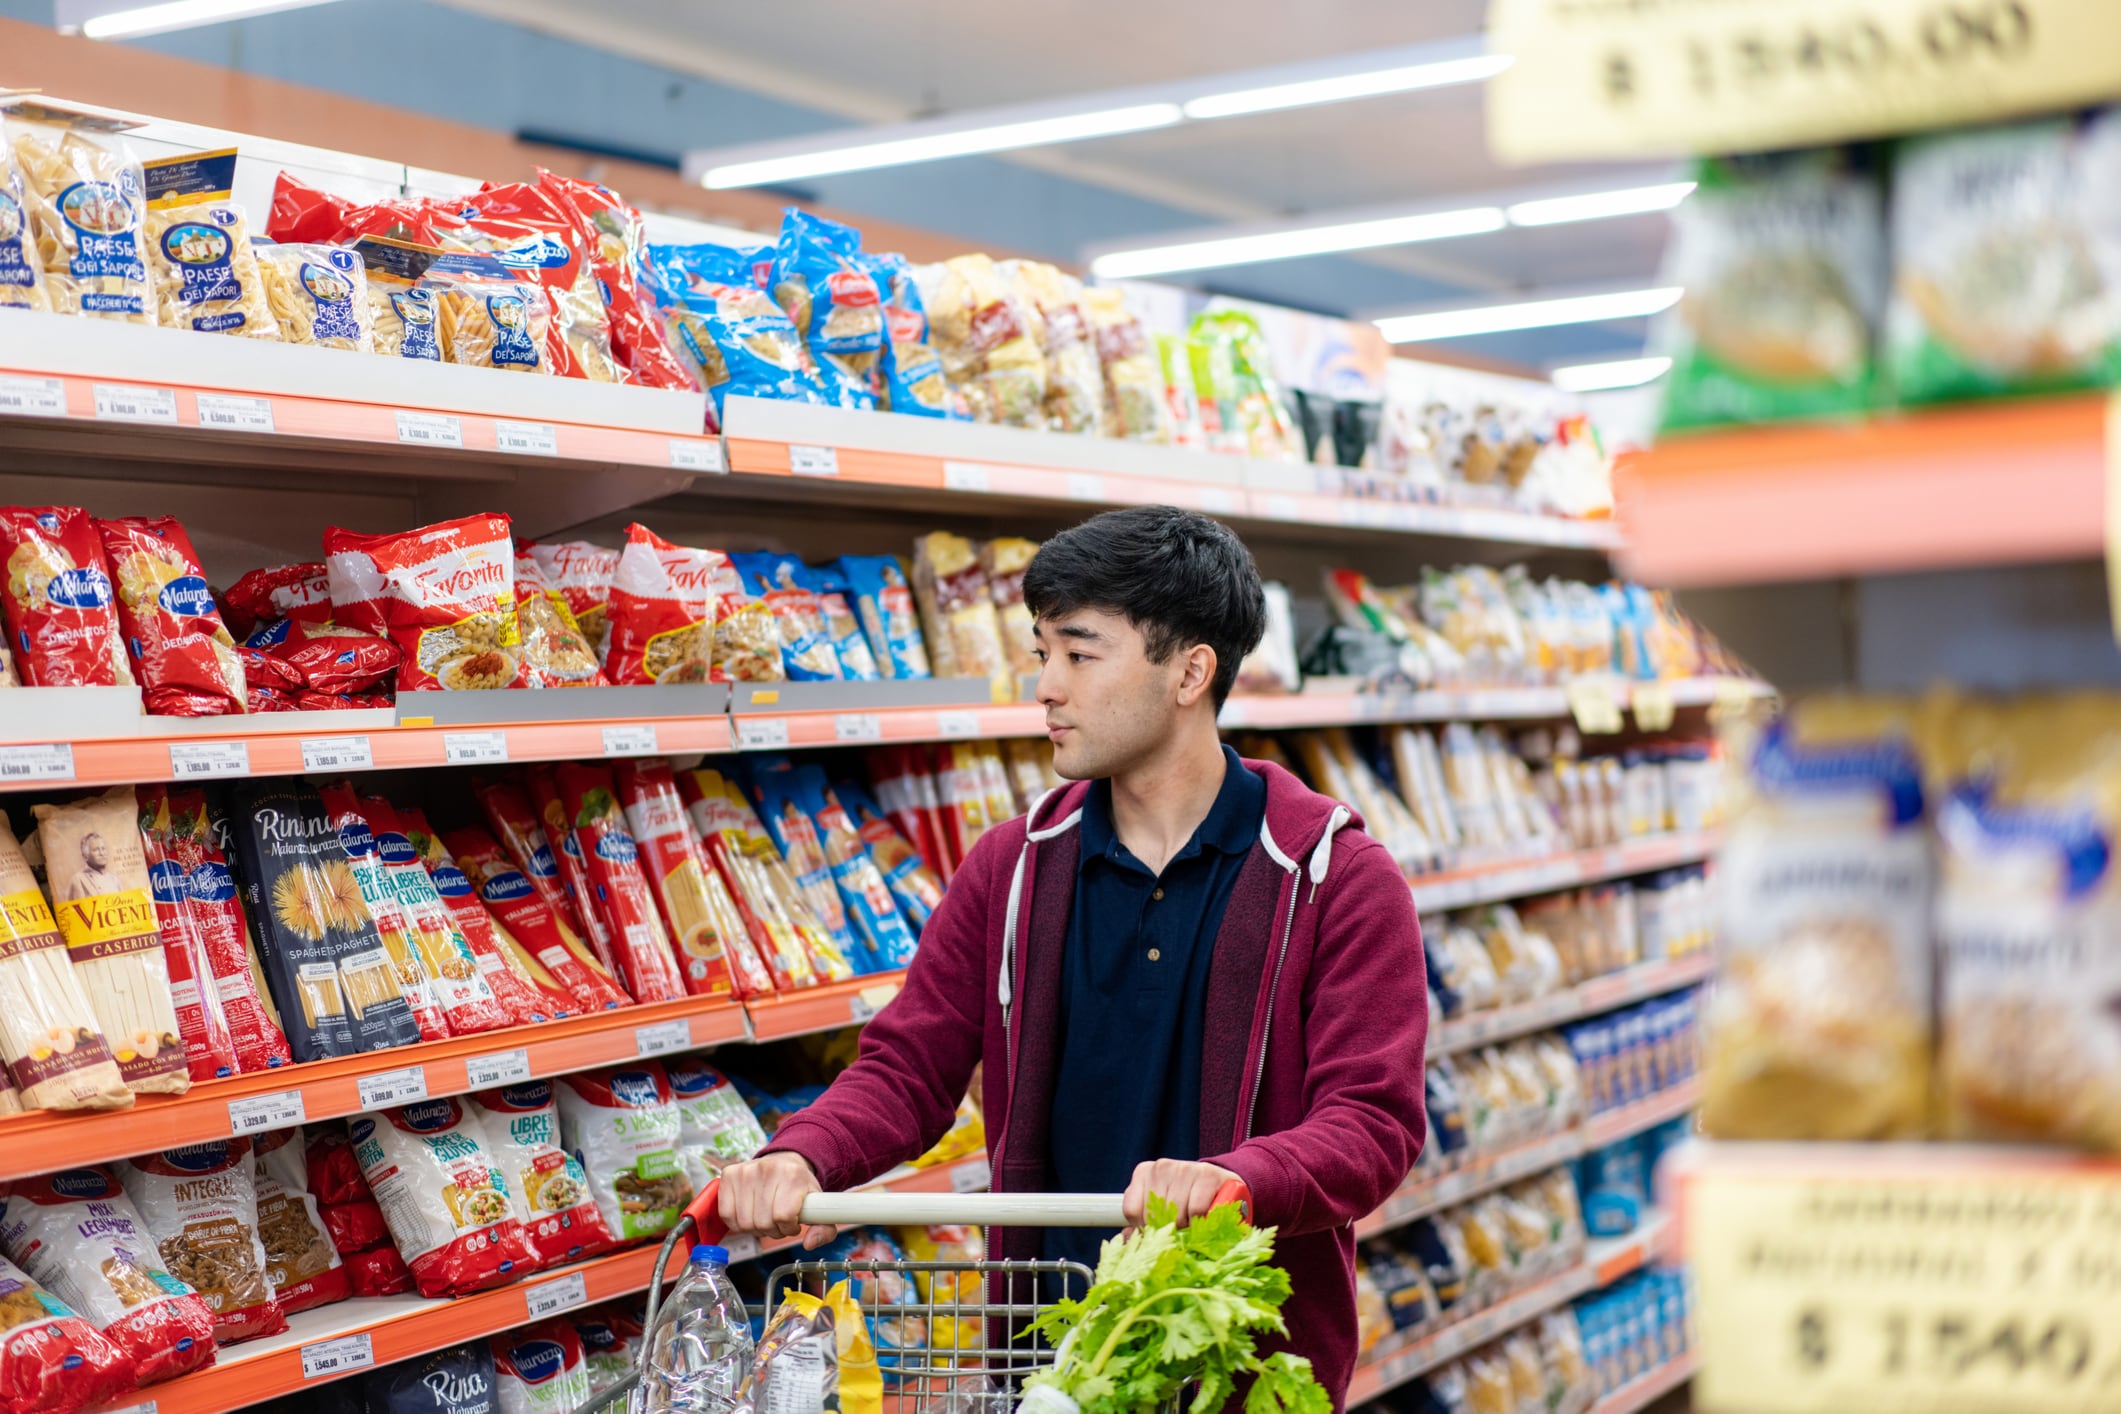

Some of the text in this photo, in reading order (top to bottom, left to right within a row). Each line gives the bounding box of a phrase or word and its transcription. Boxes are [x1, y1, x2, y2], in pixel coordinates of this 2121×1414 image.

[81, 235, 134, 256] PAESE
[74, 259, 96, 273] DEI
[335, 253, 346, 267] 7
[184, 266, 230, 284] PAESE
[183, 285, 236, 302] DEI SAPORI
[495, 348, 536, 362] DEI SAPORI
[414, 559, 505, 601] Favorita
[92, 934, 158, 956] CASERITO
[244, 1114, 268, 1127] 1,329.00
[614, 1116, 626, 1135] 3
[435, 1138, 480, 1162] GLUTEN
[174, 1175, 238, 1203] INTEGRAL
[86, 1202, 112, 1216] MIX
[268, 1199, 288, 1214] FIBRA
[315, 1358, 338, 1370] 1,545.00
[422, 1370, 488, 1406] Rina
